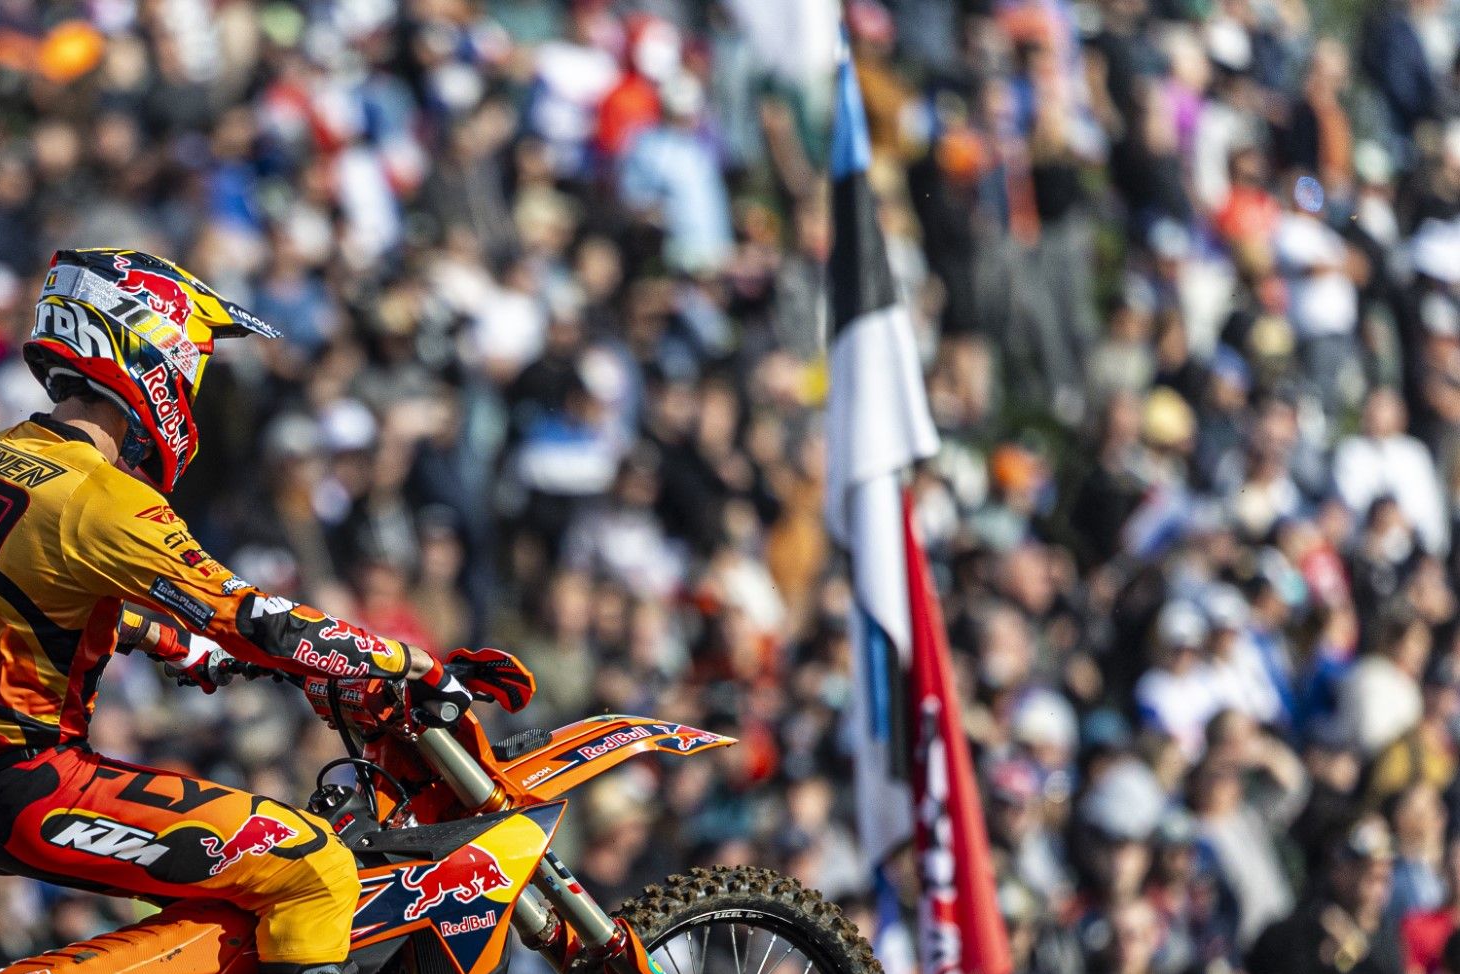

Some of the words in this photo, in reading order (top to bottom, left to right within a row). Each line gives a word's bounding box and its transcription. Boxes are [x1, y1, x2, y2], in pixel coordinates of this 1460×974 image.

[141, 363, 177, 423] Red
[293, 640, 333, 674] Red
[578, 736, 616, 761] Red
[614, 726, 652, 748] Bull
[521, 766, 552, 787] AIROH
[50, 818, 170, 866] KTM
[441, 916, 470, 937] Red
[469, 910, 496, 931] Bull
